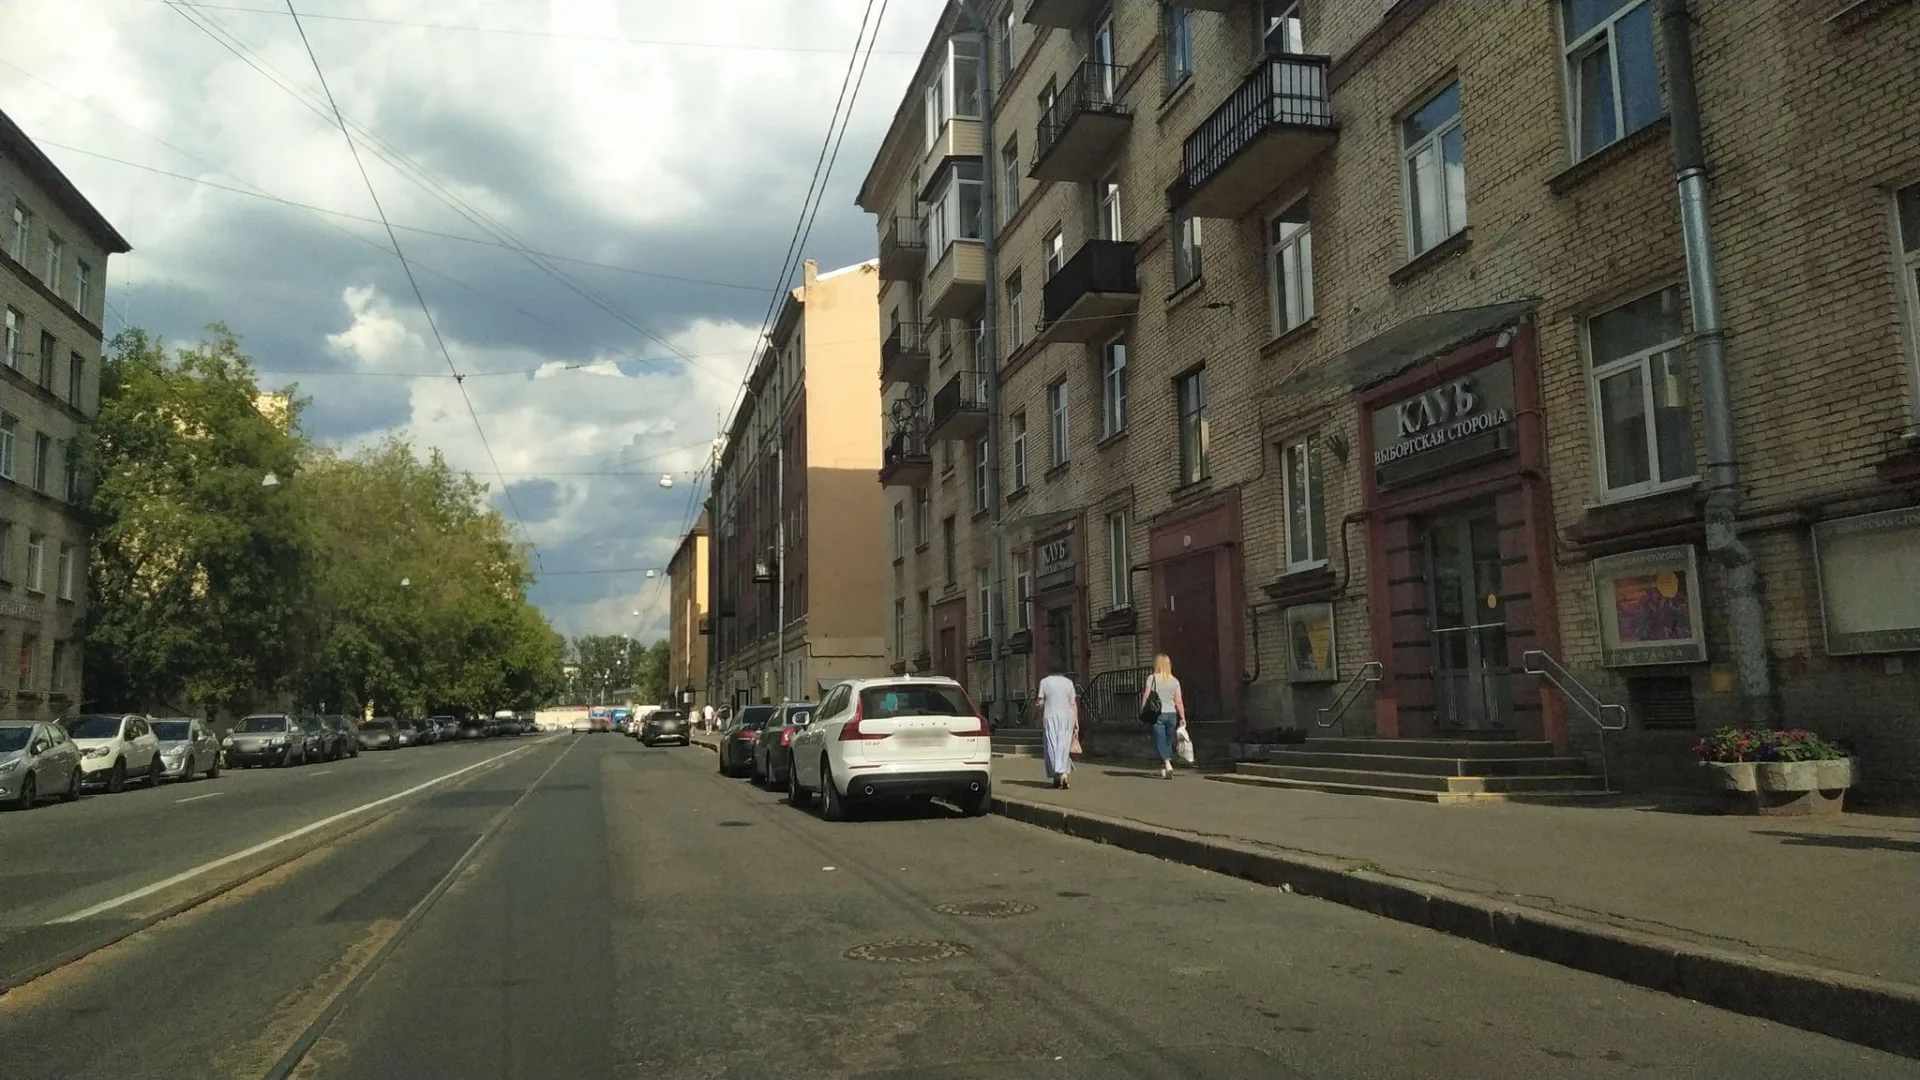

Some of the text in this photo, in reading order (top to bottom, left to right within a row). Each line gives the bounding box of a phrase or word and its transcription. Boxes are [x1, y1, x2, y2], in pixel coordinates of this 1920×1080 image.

[1373, 407, 1508, 466] ВЫБОРГСКАЯ СТОРОНА
[1394, 379, 1473, 437] КЛУБ
[1042, 540, 1065, 565] КЛУБ
